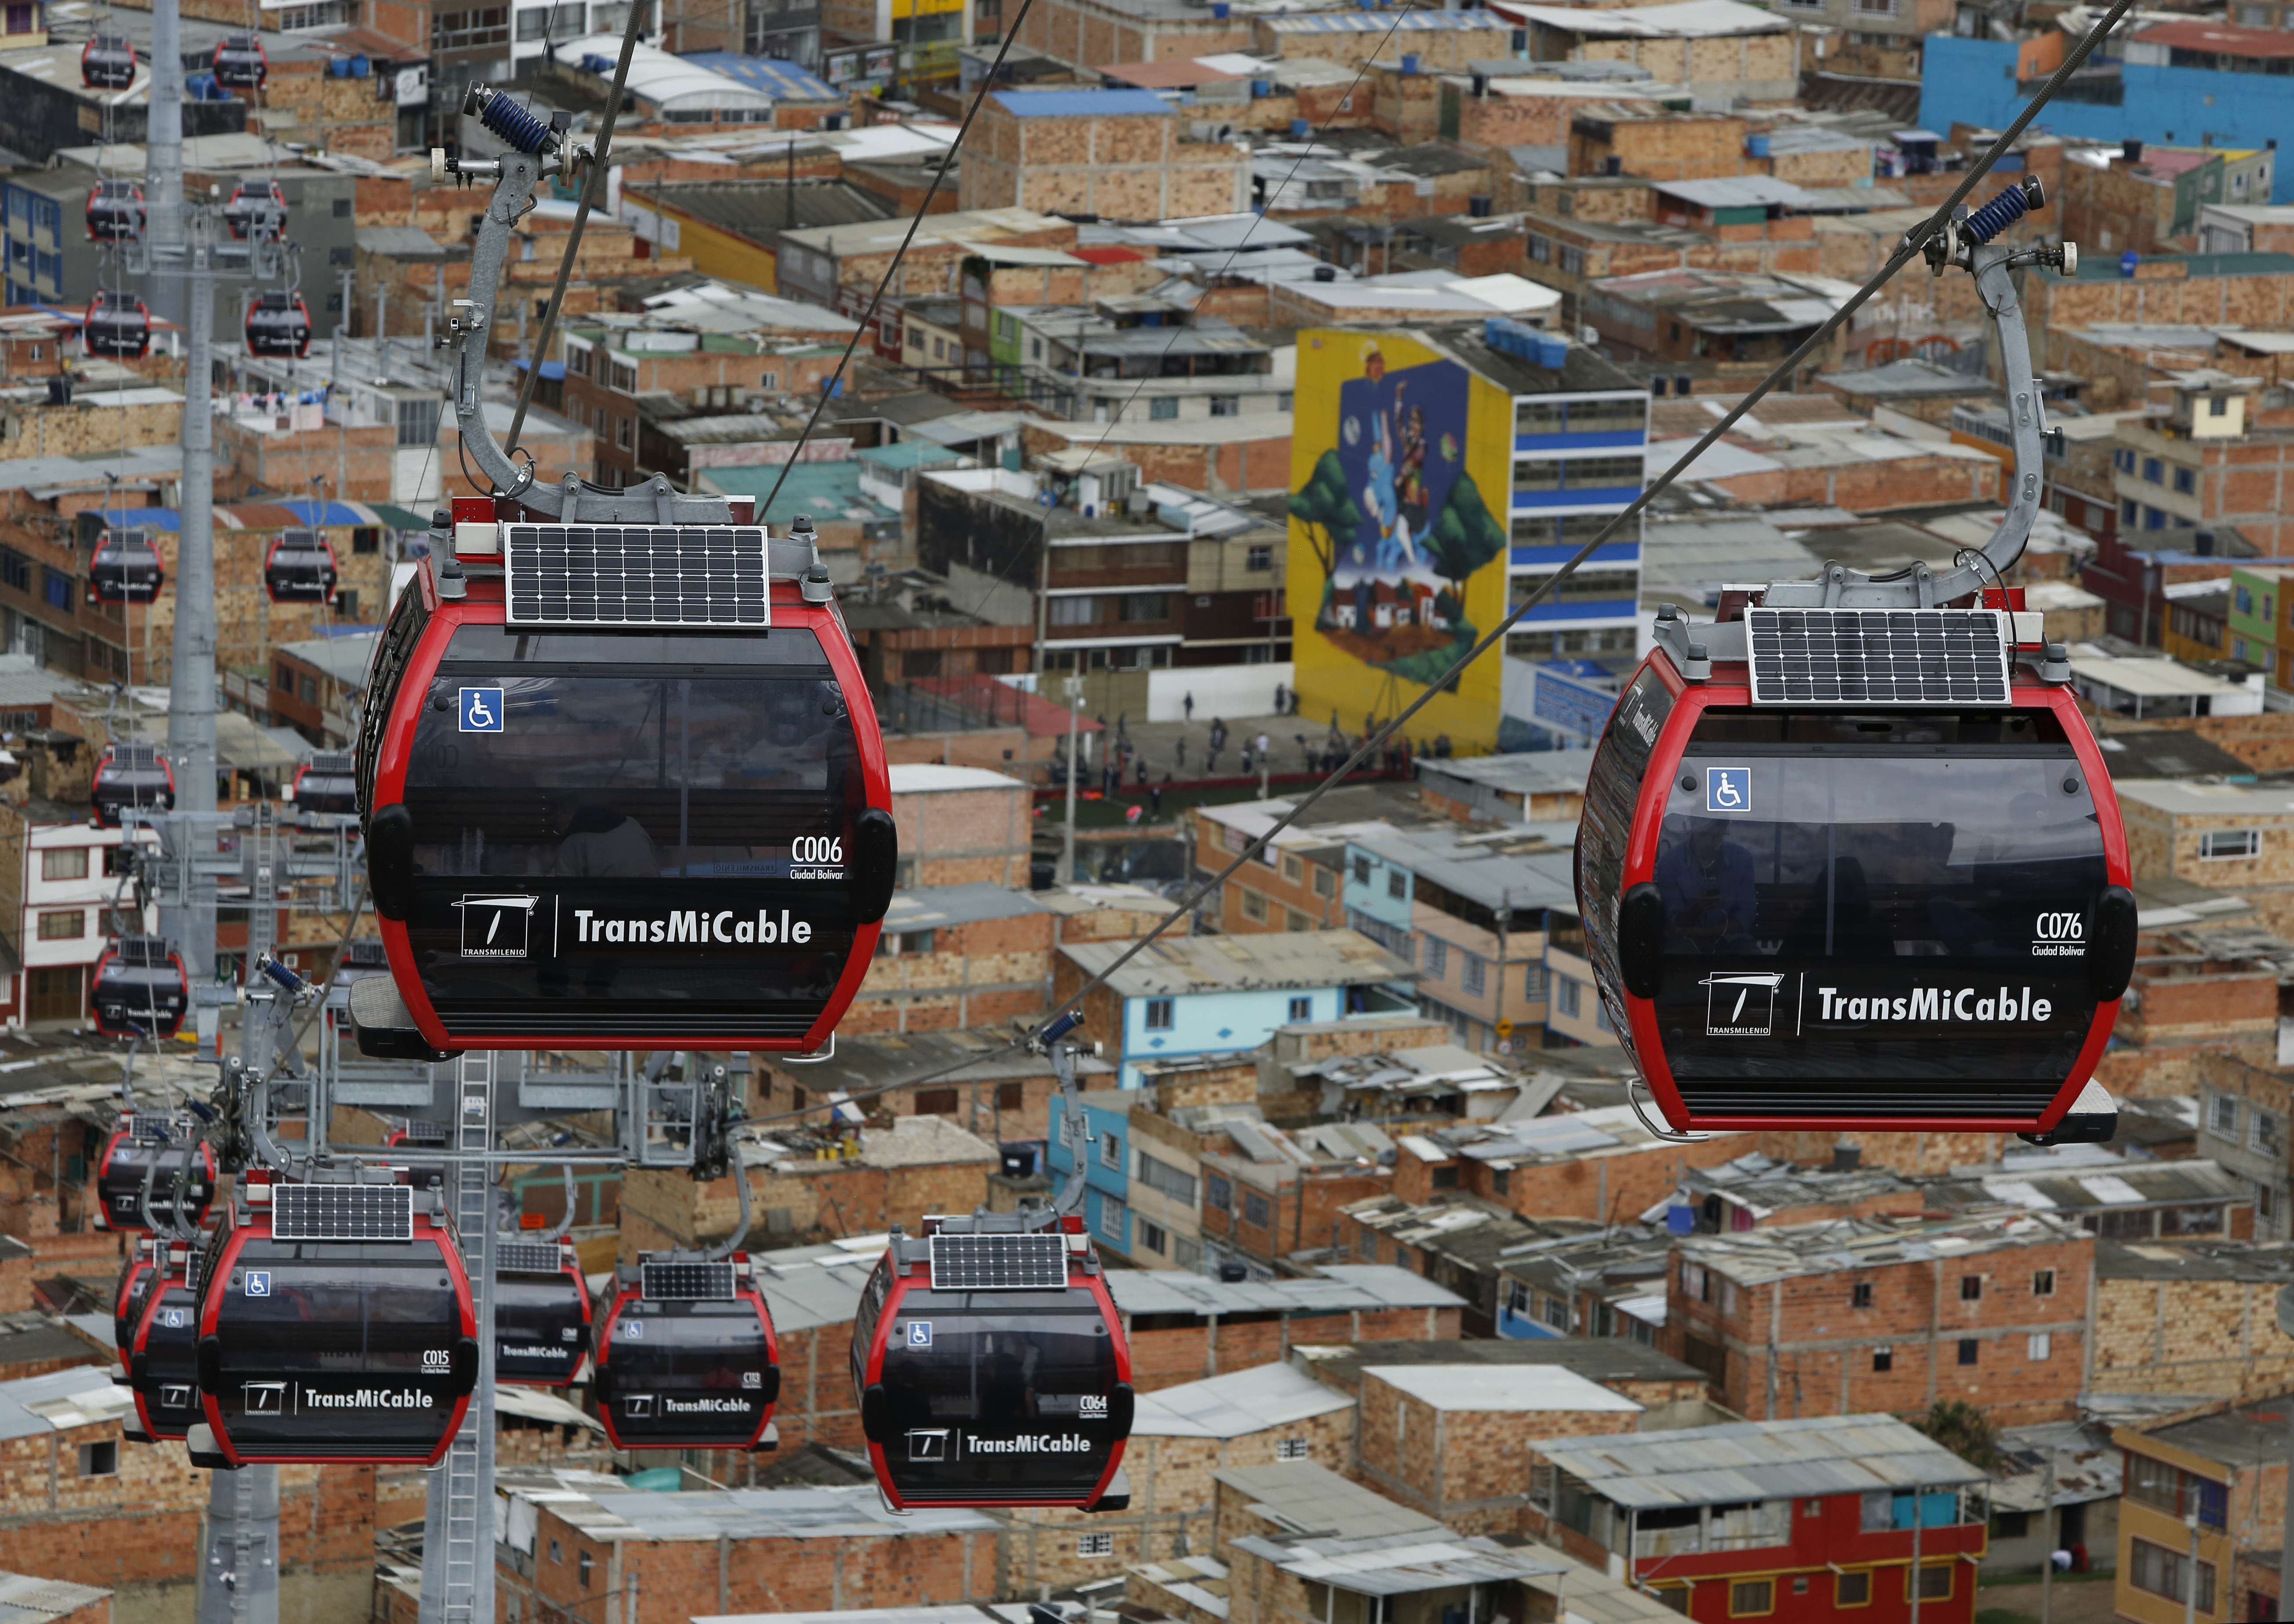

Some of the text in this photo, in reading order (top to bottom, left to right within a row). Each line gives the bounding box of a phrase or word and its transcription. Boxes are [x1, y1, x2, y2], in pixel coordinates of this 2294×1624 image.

[792, 836, 843, 862] C006
[790, 868, 844, 880] Ciudad Bolívar
[575, 909, 812, 944] TransMiCable
[2037, 912, 2082, 939] C076
[2032, 945, 2085, 956] Ciudad Bolívar
[1818, 986, 2052, 1021] TransMiCable
[423, 1350, 449, 1366] C015
[306, 1388, 433, 1408] TransMiCable
[666, 1398, 751, 1412] TransMiCable
[1079, 1395, 1107, 1411] C064
[967, 1433, 1091, 1453] TransMiCable
